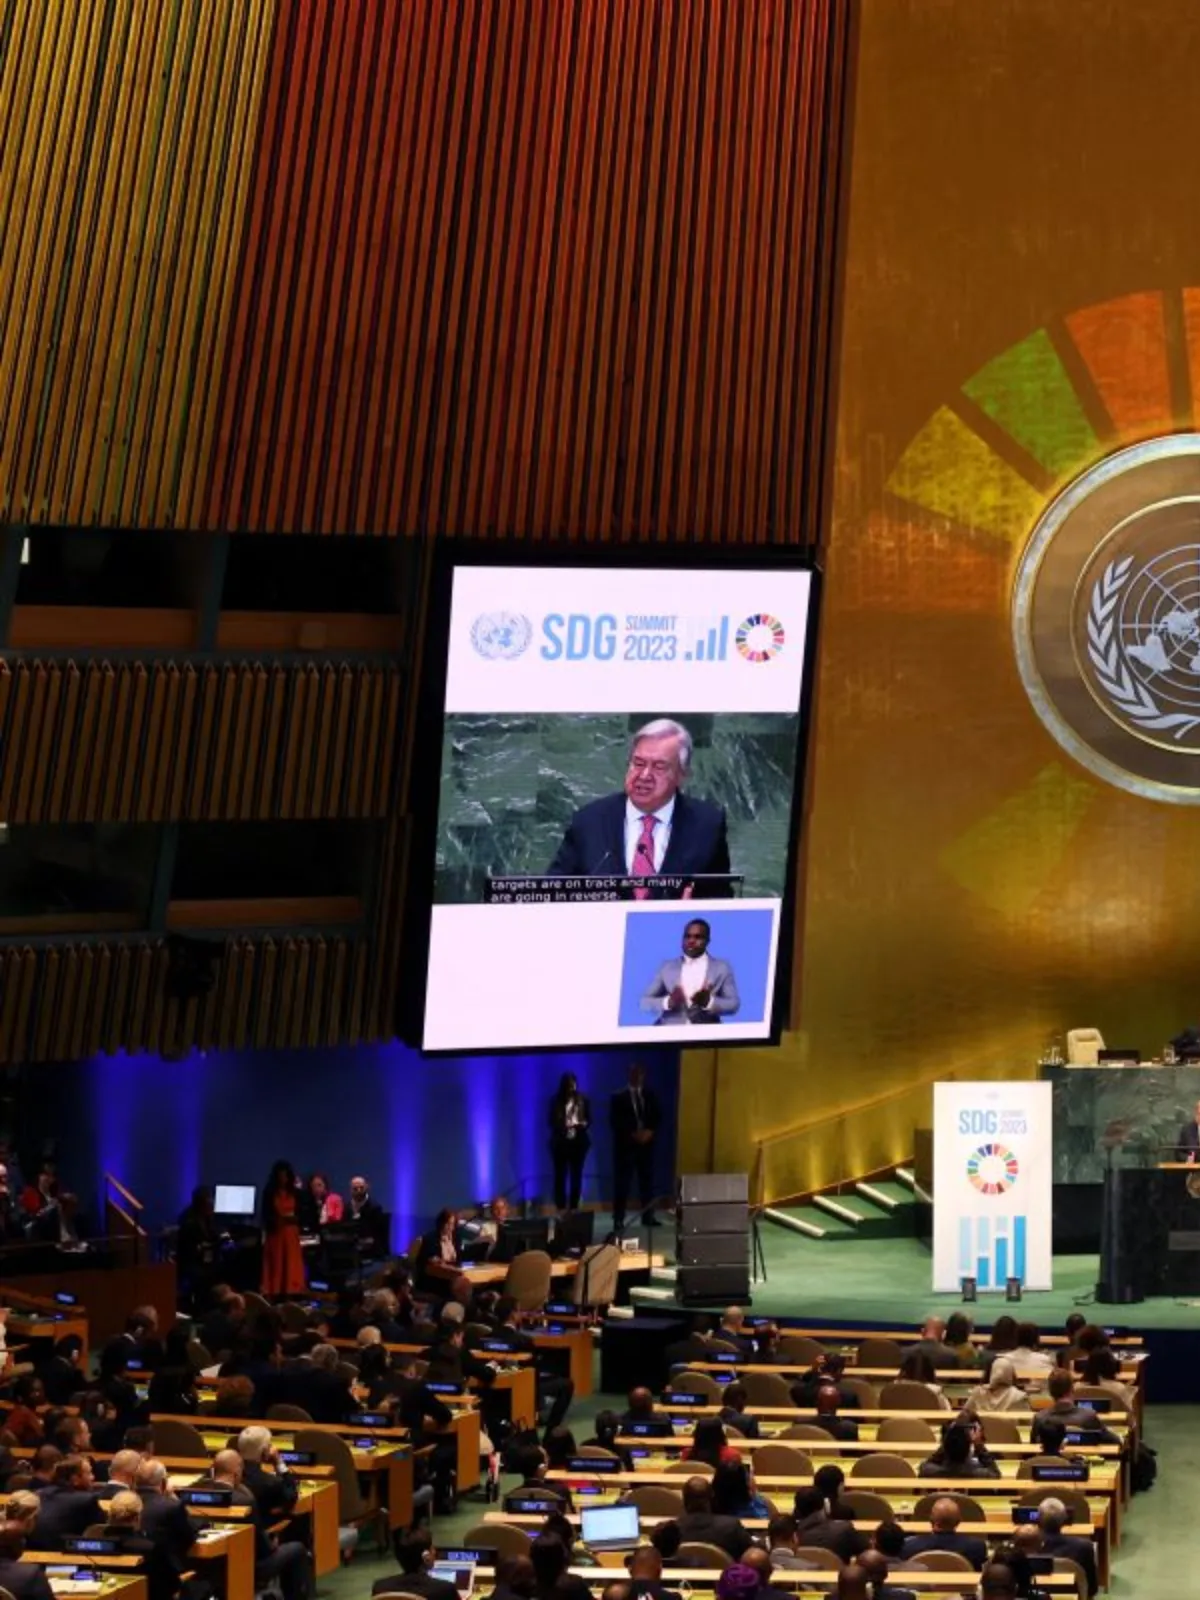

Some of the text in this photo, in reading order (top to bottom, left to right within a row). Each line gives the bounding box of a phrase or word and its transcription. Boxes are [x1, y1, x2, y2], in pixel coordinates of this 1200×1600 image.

[625, 615, 678, 631] SUMMIT
[540, 613, 617, 661] SDG
[623, 634, 677, 661] 2023
[491, 877, 682, 891] targets are on track and many
[491, 890, 621, 903] are going in reverse.
[959, 1109, 997, 1135] SDG
